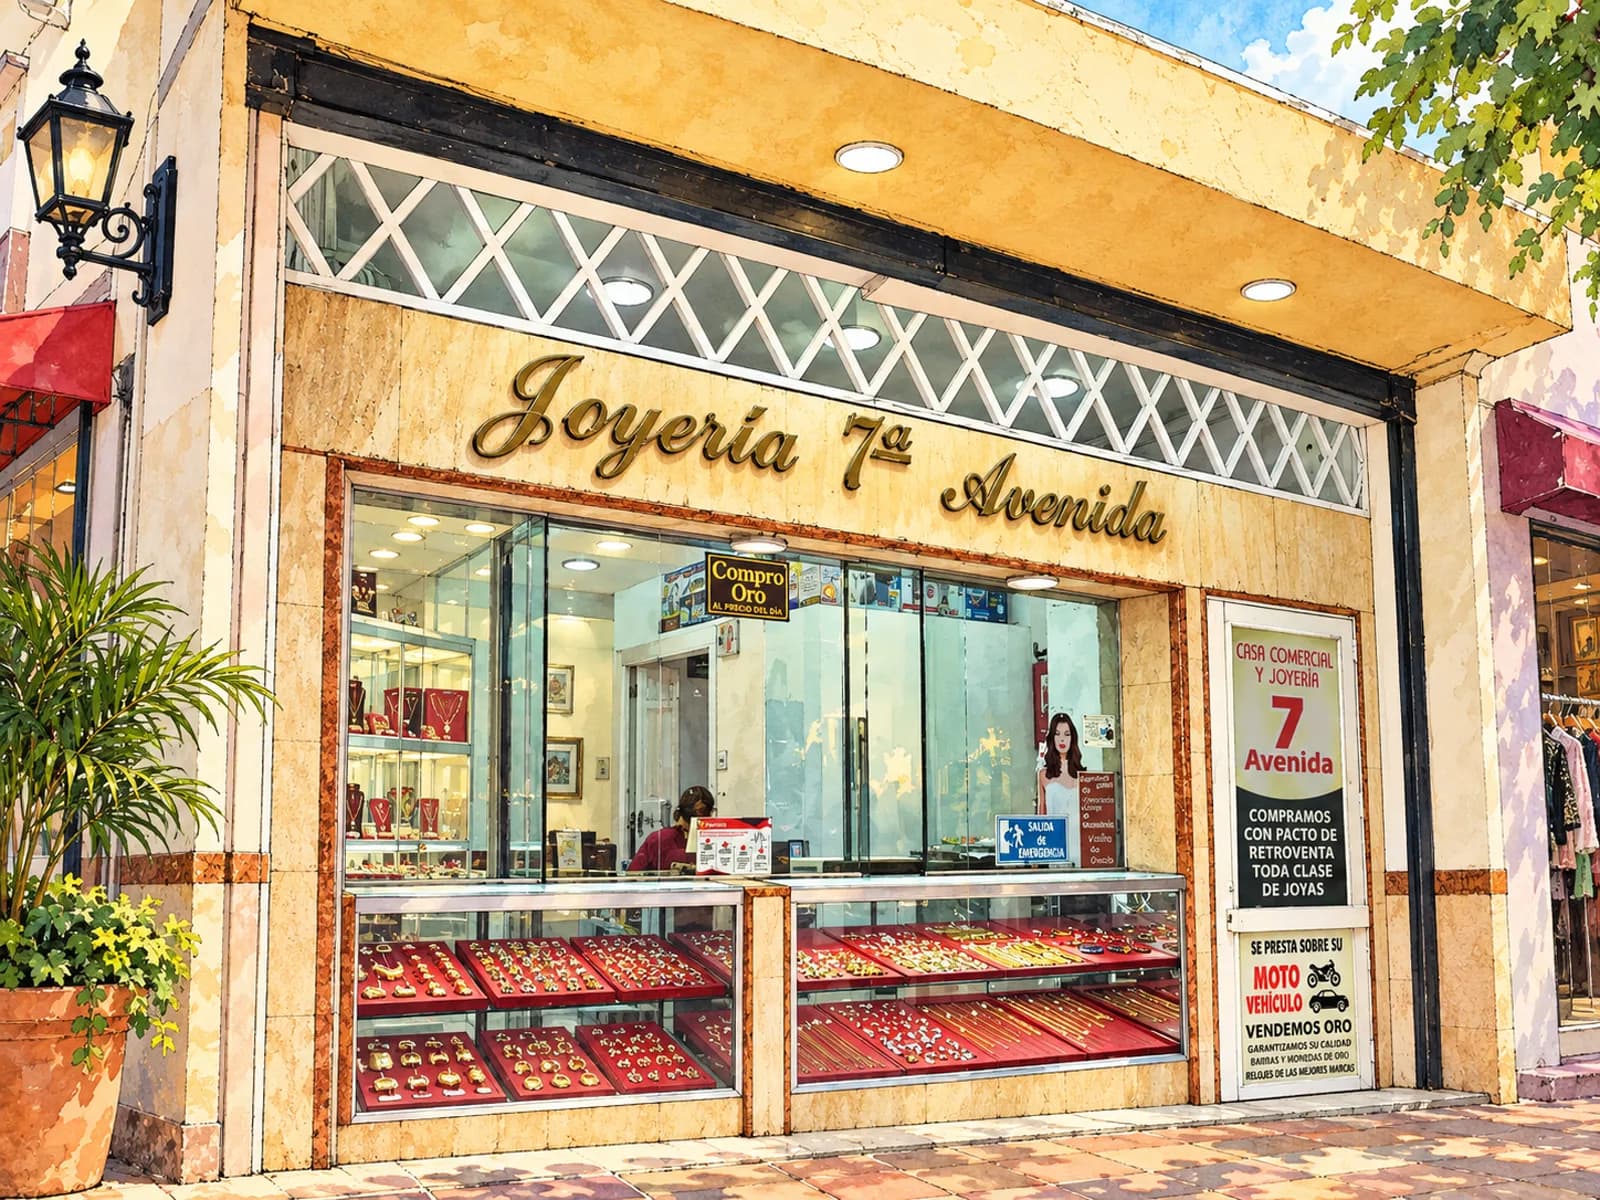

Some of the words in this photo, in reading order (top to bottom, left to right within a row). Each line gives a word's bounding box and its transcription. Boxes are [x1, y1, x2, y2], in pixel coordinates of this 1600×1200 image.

[472, 354, 799, 480] Joyería
[941, 453, 1167, 544] Avenida
[712, 560, 784, 588] Compro
[731, 583, 767, 604] Oro
[712, 601, 723, 610] AL
[1236, 643, 1265, 661] CASA
[1269, 646, 1334, 669] COMERCIAL
[1255, 666, 1264, 683] Y
[1269, 668, 1319, 688] JOYERÍA
[1271, 695, 1304, 749] 7
[1244, 749, 1333, 774] Avenida
[1249, 808, 1331, 823] COMPRAMOS
[1028, 821, 1054, 832] SALIDA
[1244, 827, 1272, 841] CON
[1276, 827, 1318, 841] PACTO
[1321, 828, 1337, 841] DE
[1249, 846, 1335, 859] RETROVENTA
[1252, 864, 1290, 878] TODA
[1293, 864, 1333, 878] CLASE
[1262, 883, 1280, 896] DE
[1283, 882, 1324, 896] JOYAS
[1251, 940, 1262, 955] SE
[1264, 939, 1298, 954] PRESTA
[1300, 938, 1329, 952] SOBRE
[1331, 937, 1343, 951] SU
[1253, 964, 1300, 990] MOTO
[1246, 991, 1303, 1014] VEHÍCULO
[1245, 1021, 1321, 1039] VENDEMOS
[1324, 1019, 1352, 1034] ORO
[1247, 1041, 1308, 1054] GARANTIZAMOS
[1309, 1040, 1319, 1049] SU
[1320, 1038, 1352, 1049] CALIDAD
[1281, 1055, 1287, 1064] Y
[1324, 1052, 1334, 1061] DE
[1245, 1070, 1274, 1081] RELOJES
[1275, 1069, 1285, 1078] DE
[1285, 1067, 1298, 1077] LAS
